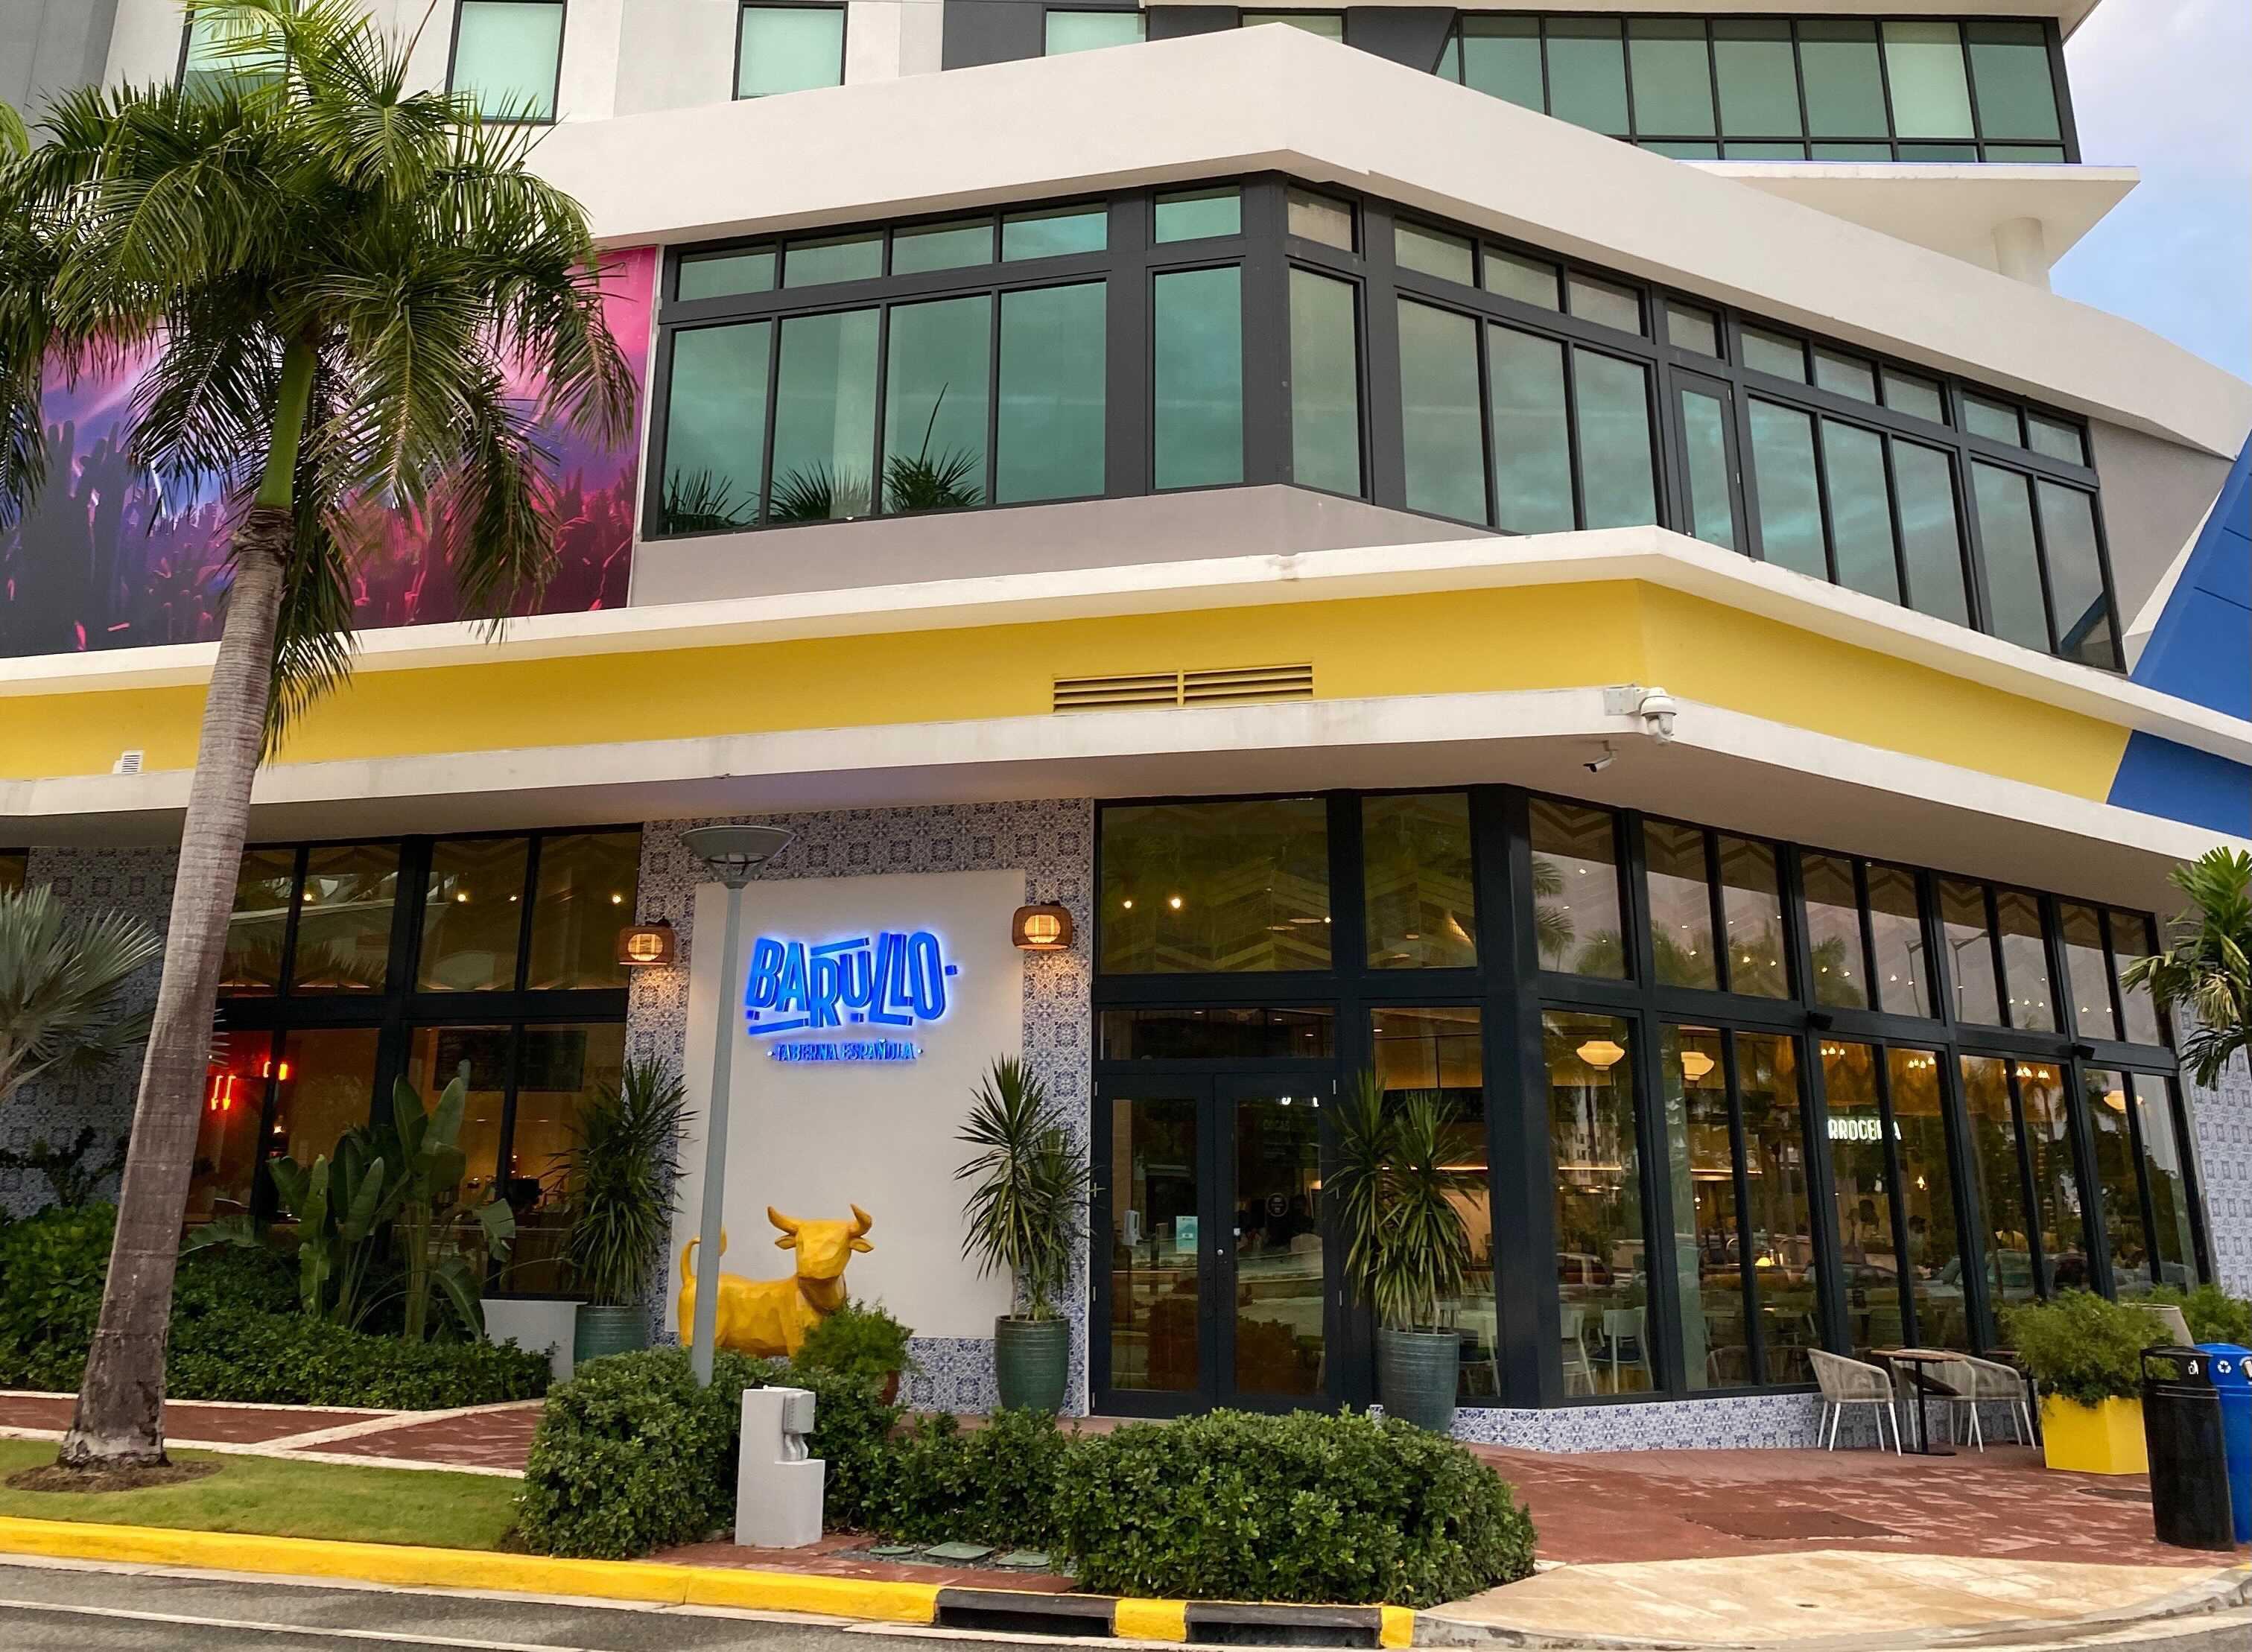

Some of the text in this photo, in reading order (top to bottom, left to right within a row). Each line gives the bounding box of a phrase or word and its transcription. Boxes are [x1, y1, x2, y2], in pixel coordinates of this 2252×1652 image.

[746, 931, 947, 1029] BARULLO
[776, 1038, 916, 1061] TABERNA ESPAÑOLA
